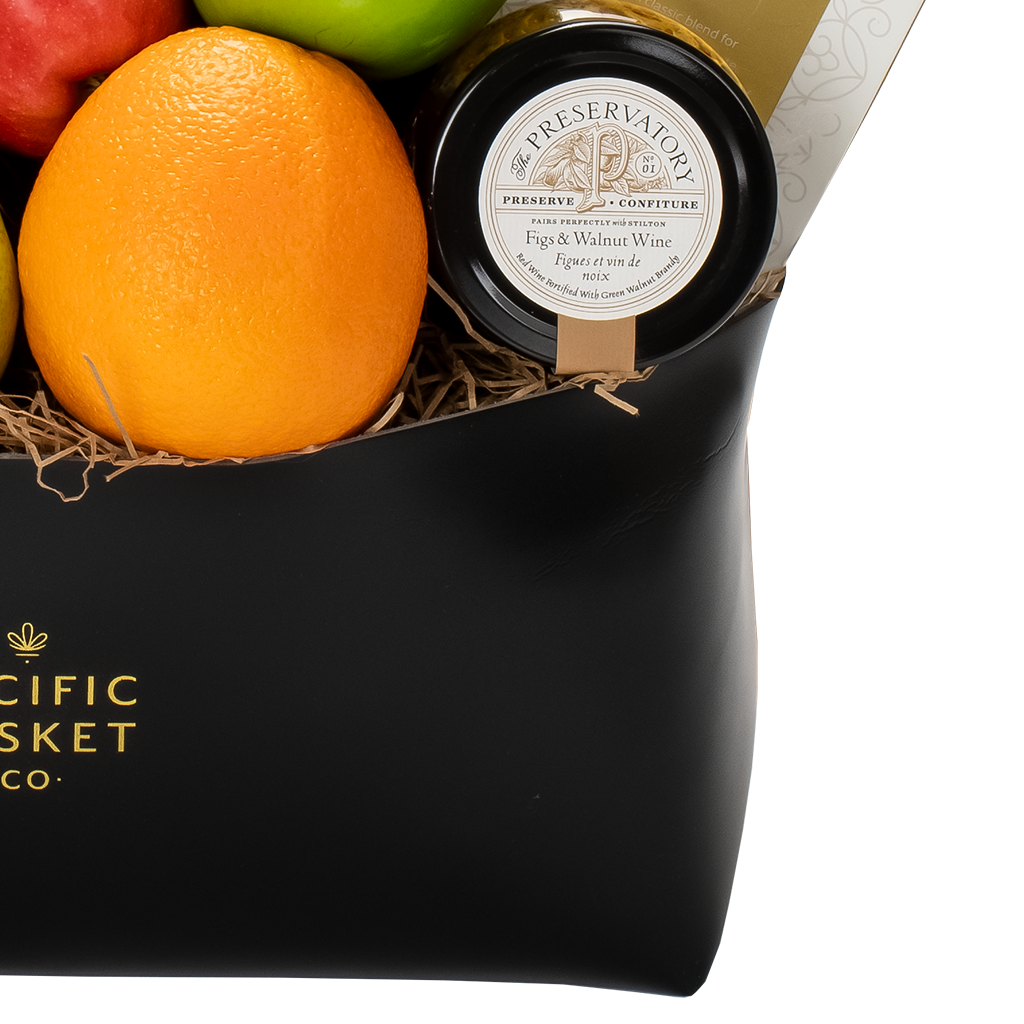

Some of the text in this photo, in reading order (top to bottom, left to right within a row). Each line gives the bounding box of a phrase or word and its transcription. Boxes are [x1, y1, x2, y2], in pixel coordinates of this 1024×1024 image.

[684, 14, 720, 40] blend
[720, 33, 740, 49] for
[510, 101, 695, 184] The PRESERVATORY
[502, 195, 699, 210] PRESERVE CONFITURE
[531, 218, 667, 228] PAIRS PERFECTLY with STILTON
[525, 230, 673, 251] Figs & Walnut Wine
[554, 252, 642, 271] Figues et vin de
[515, 252, 681, 301] Red Wine Fortified With Green Walnut Brandy
[581, 269, 611, 282] noix
